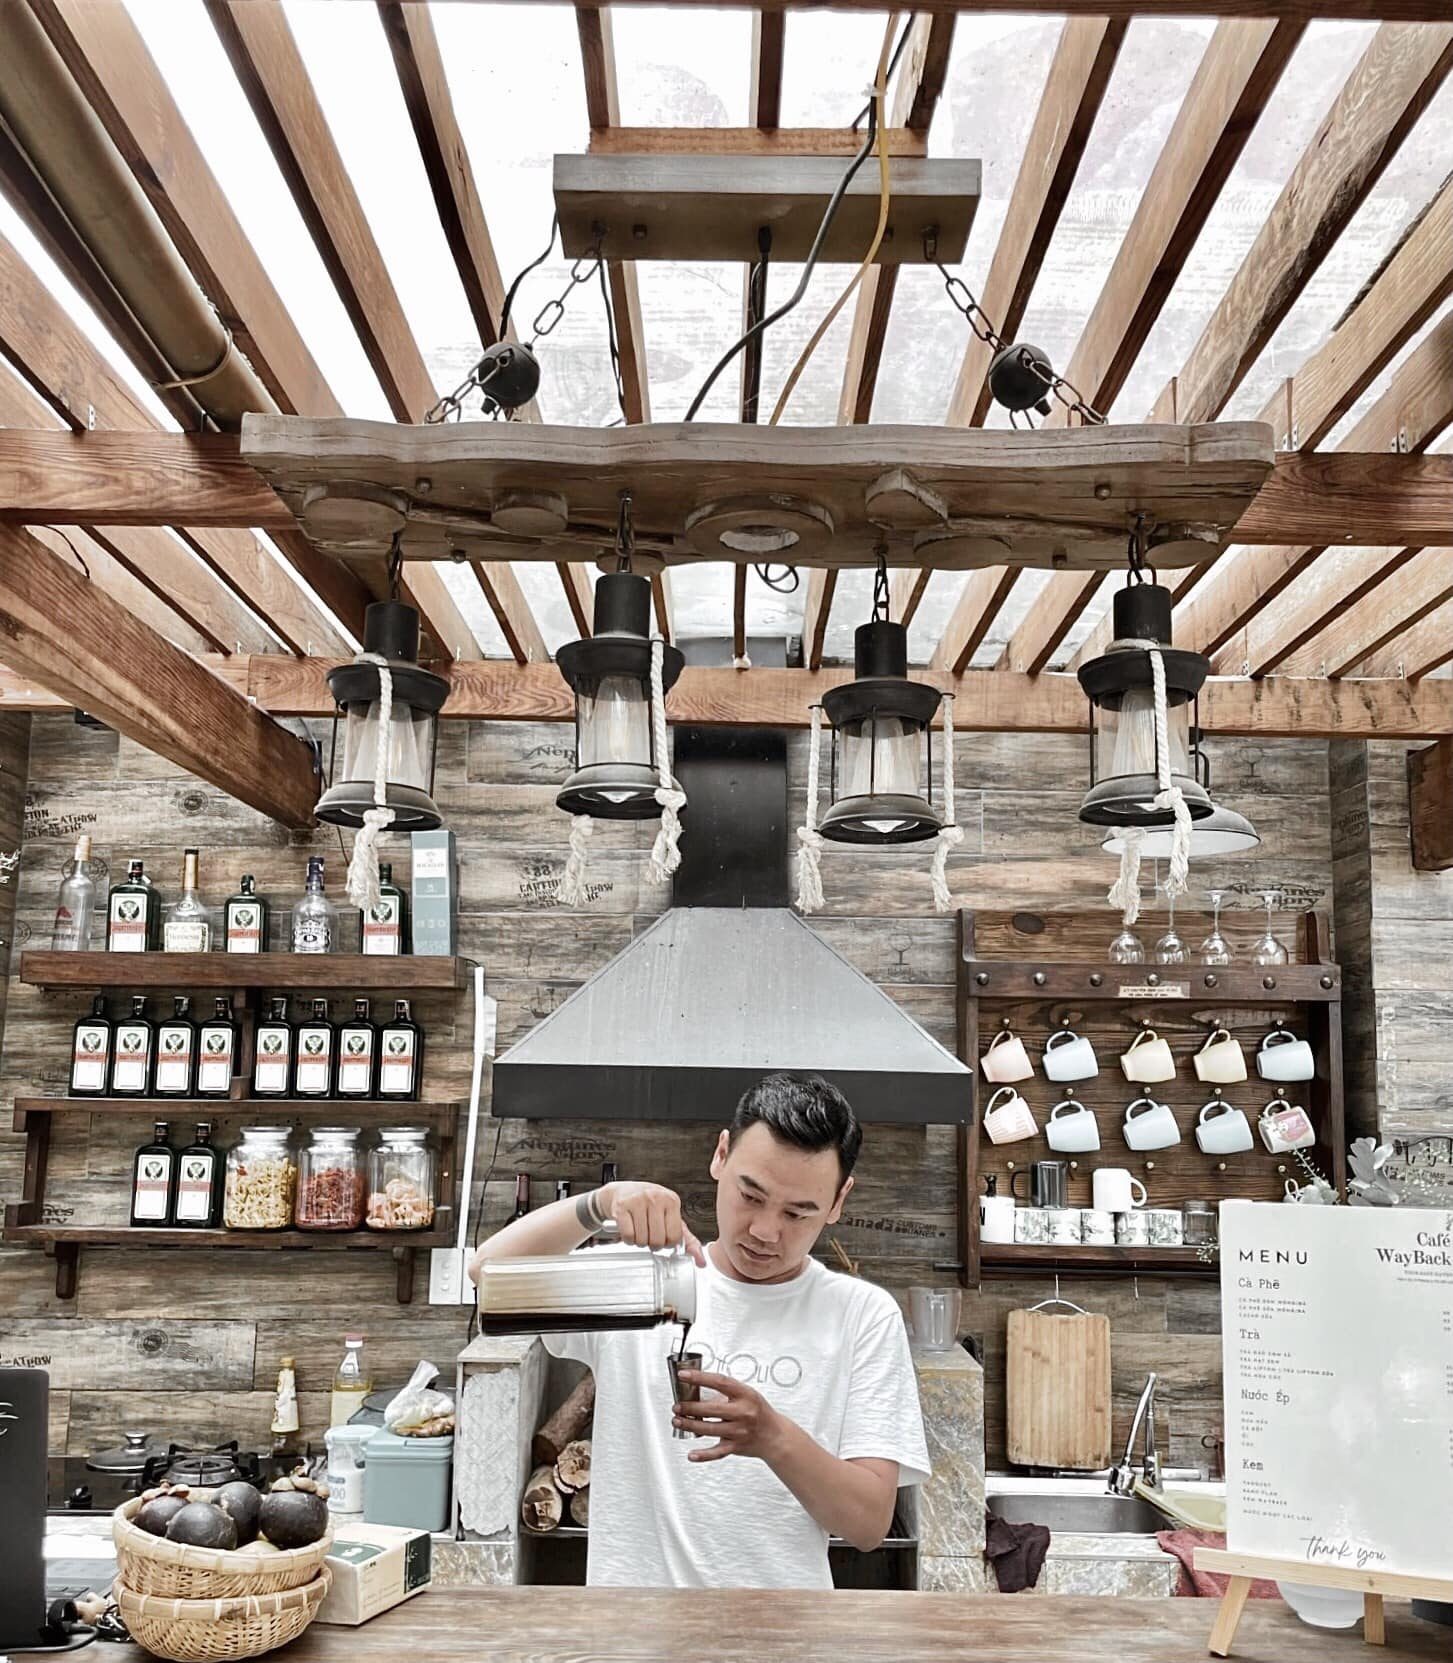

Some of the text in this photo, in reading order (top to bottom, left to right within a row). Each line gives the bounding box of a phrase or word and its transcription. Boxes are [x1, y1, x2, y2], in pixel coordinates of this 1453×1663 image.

[1417, 1232, 1451, 1247] Café
[1239, 1249, 1308, 1265] MENU
[1374, 1248, 1452, 1267] WayBack
[1239, 1328, 1260, 1340] Trà
[1242, 1458, 1264, 1471] Kem
[1357, 1546, 1387, 1568] you
